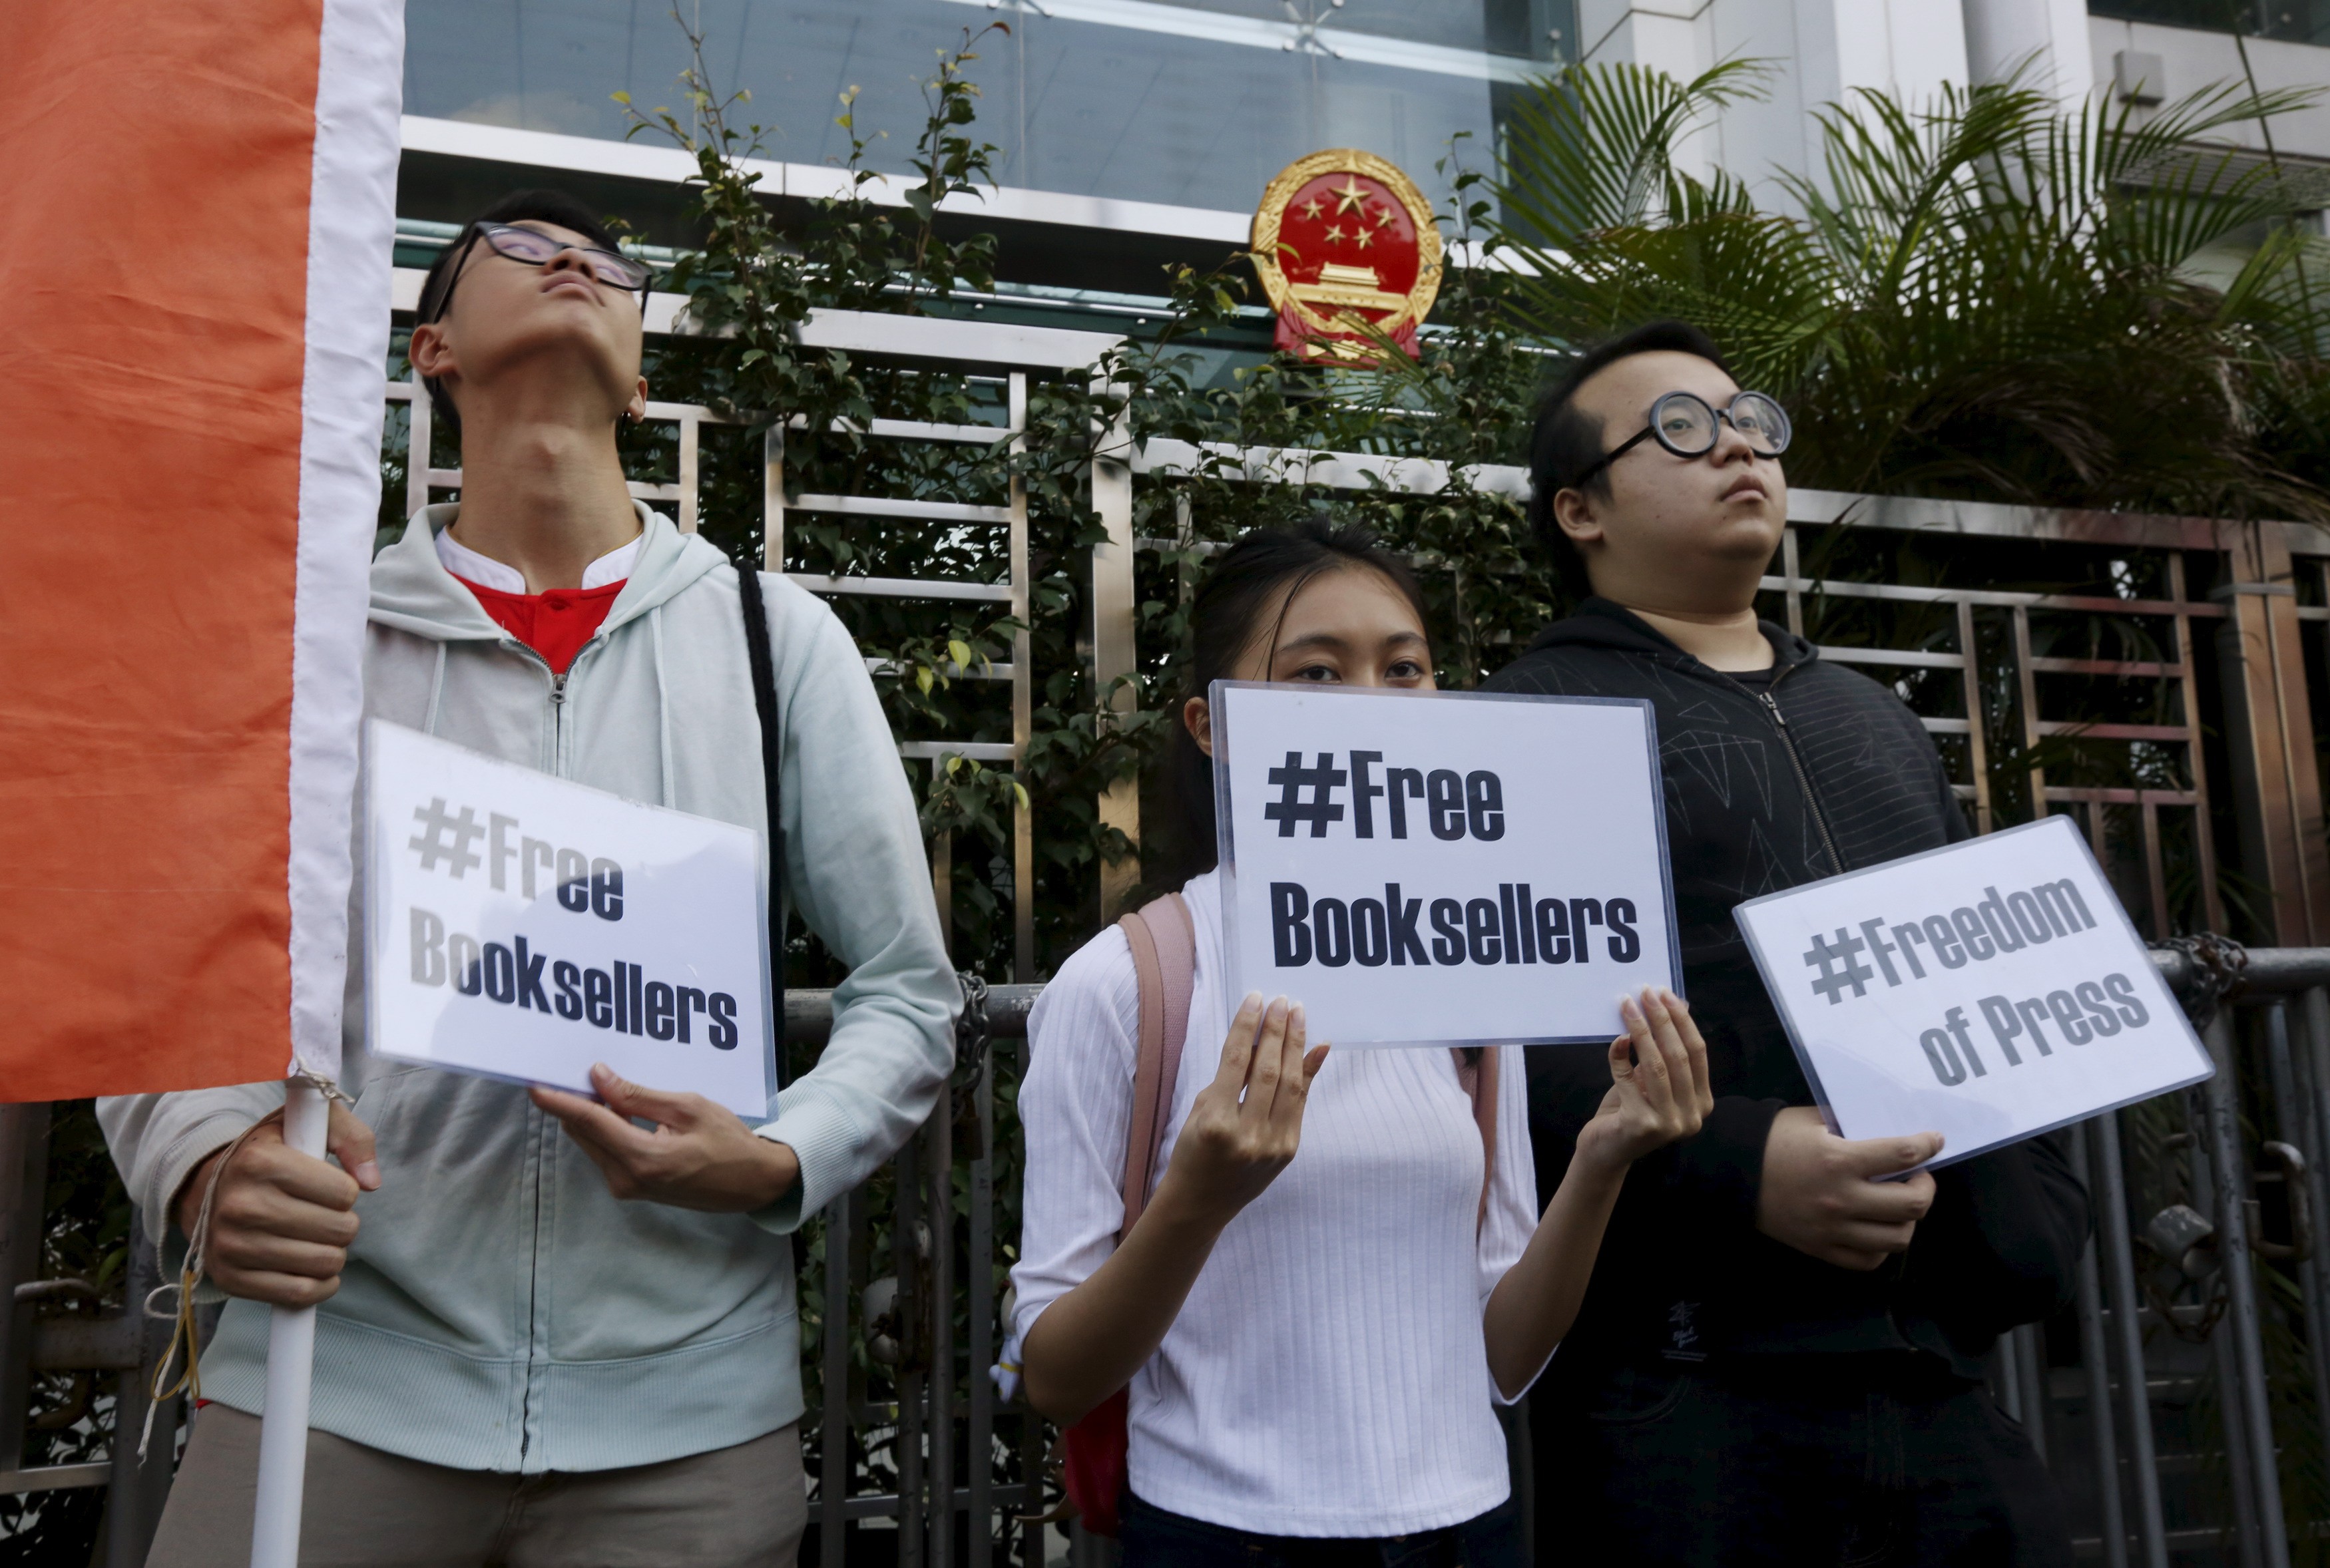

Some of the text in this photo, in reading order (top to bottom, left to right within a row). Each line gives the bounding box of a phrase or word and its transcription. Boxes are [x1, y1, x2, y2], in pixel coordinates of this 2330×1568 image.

[1265, 750, 1505, 841] #Free
[408, 796, 623, 921] #Free
[409, 906, 738, 1050] Booksellers
[1270, 882, 1640, 967] Booksellers
[1803, 878, 2097, 1006] #Freedom
[1919, 972, 2150, 1087] of Press
